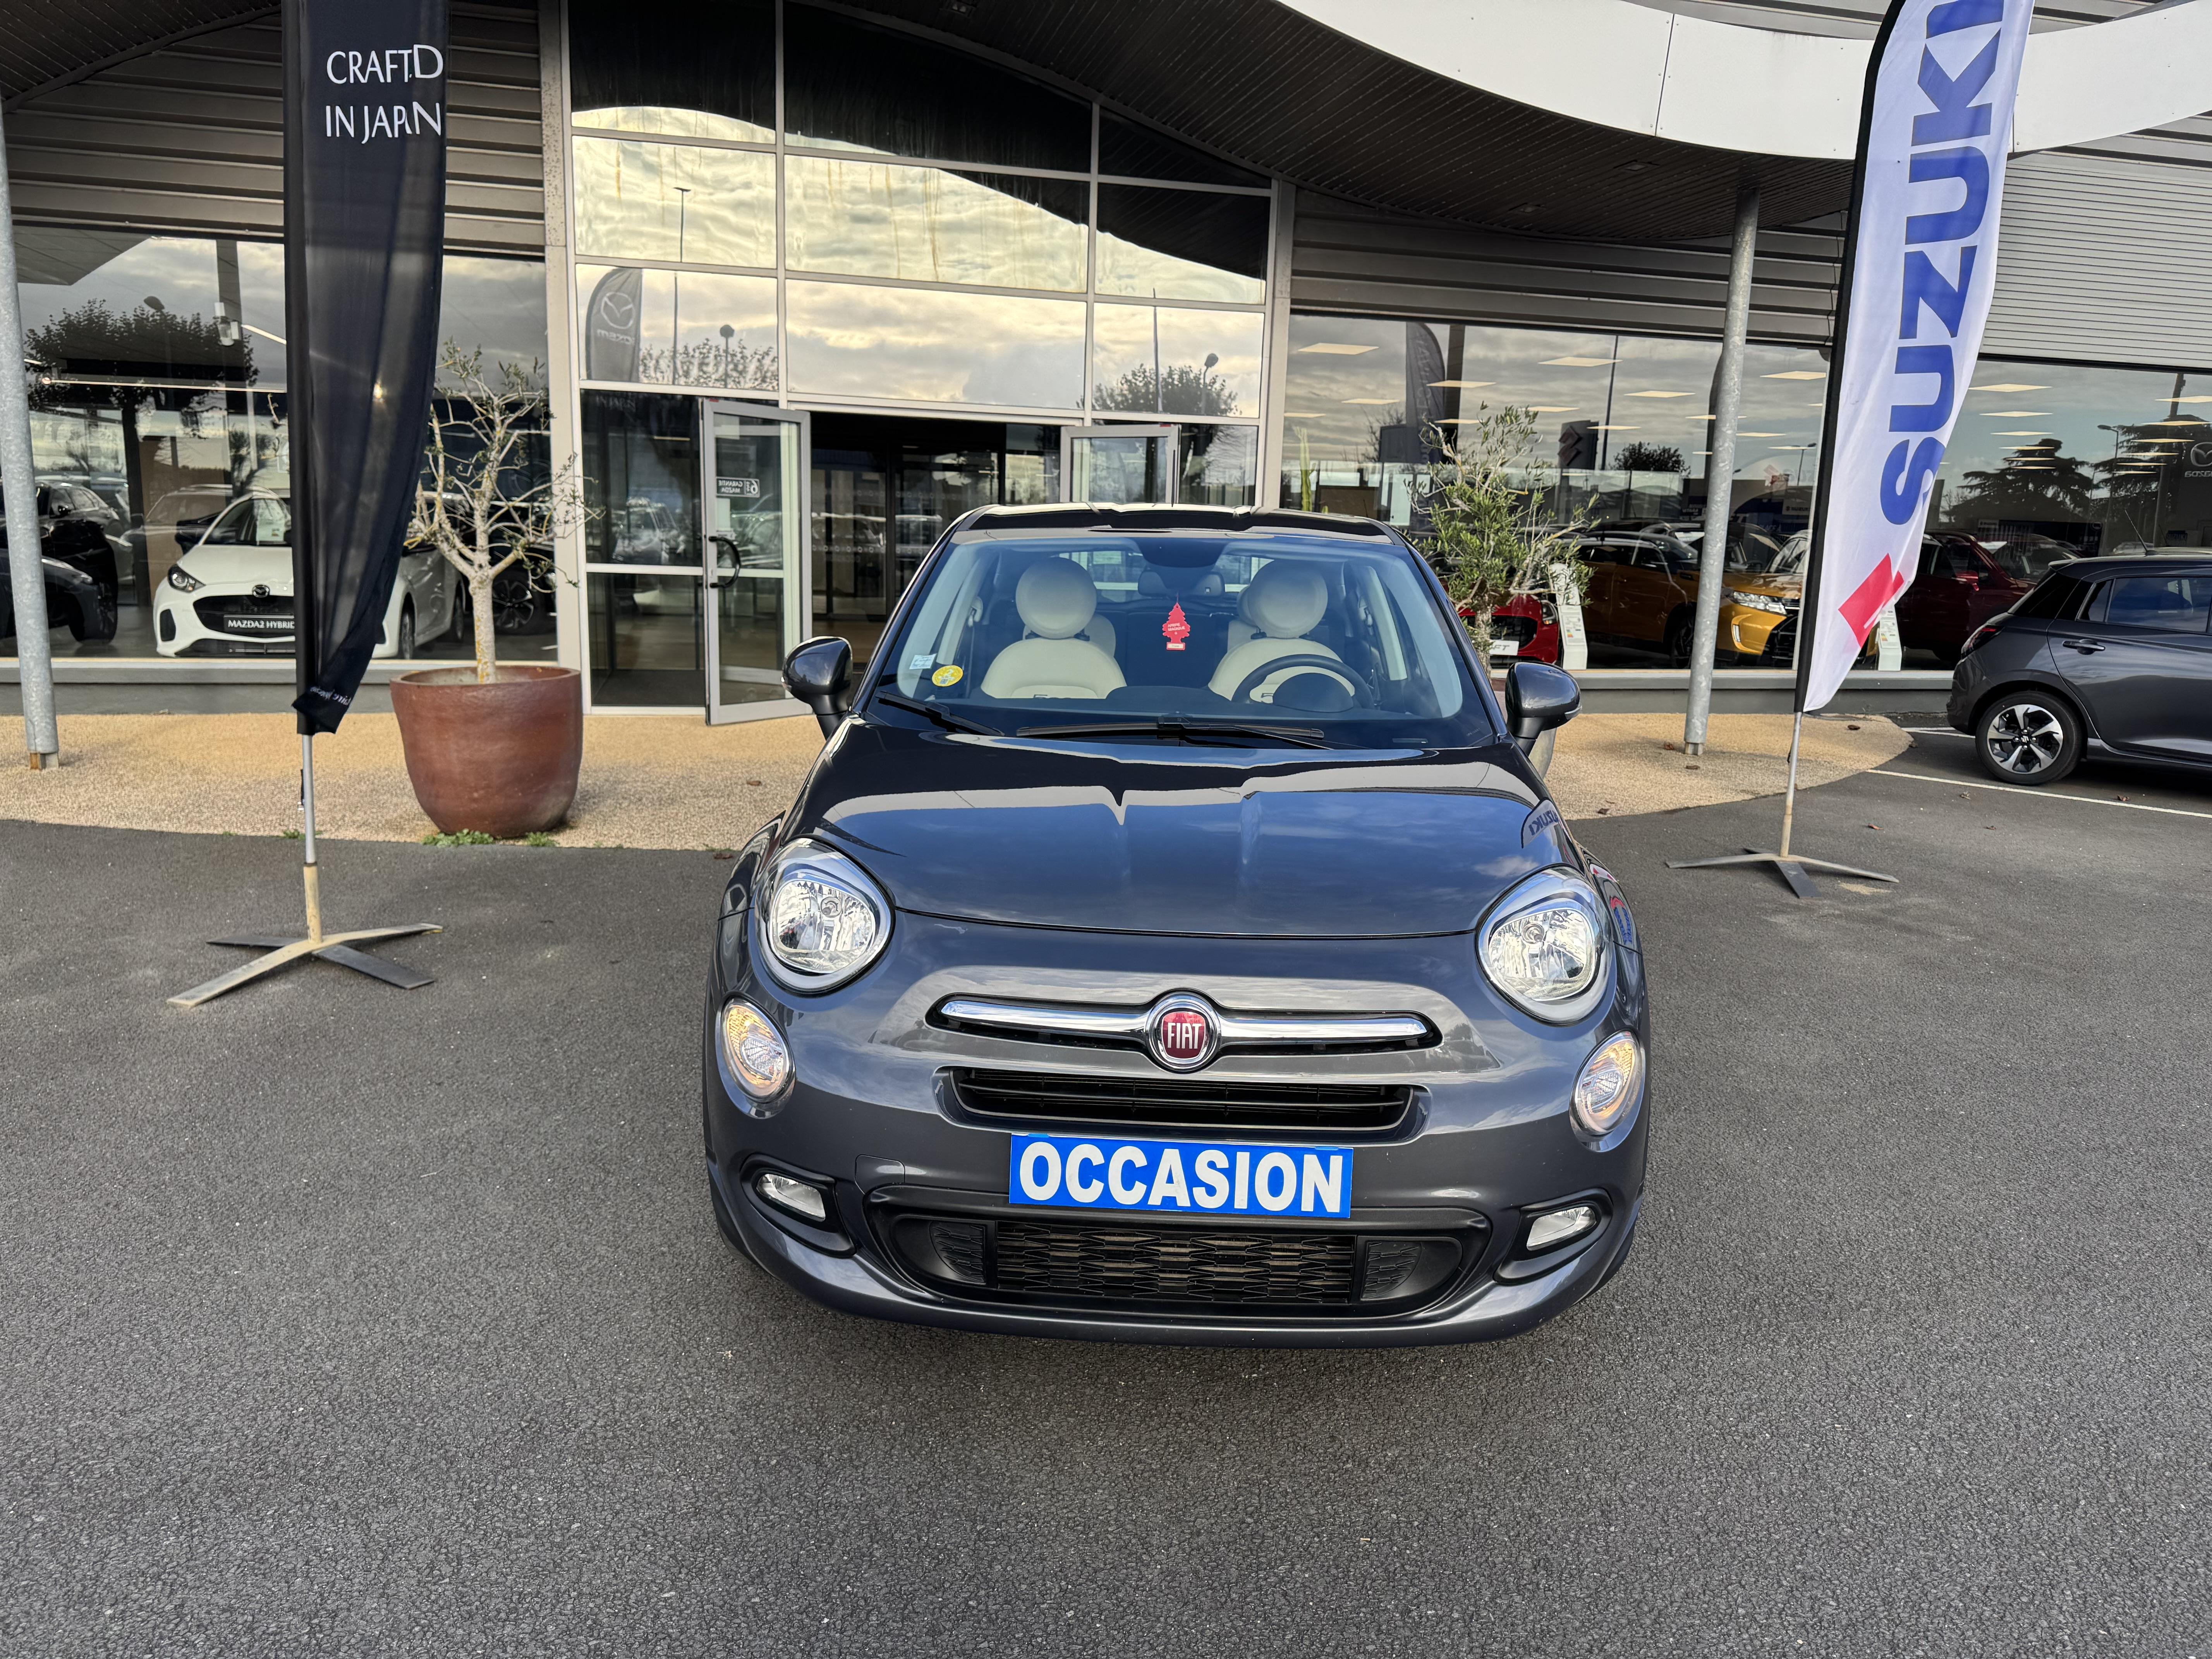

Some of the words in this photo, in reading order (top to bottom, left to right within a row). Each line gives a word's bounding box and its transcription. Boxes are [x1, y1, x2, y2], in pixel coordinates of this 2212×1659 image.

[326, 44, 444, 84] CRAFTD
[326, 105, 355, 138] IN
[1880, 0, 2004, 525] SUZUKI
[228, 620, 265, 628] MAZDA2
[1167, 1022, 1202, 1049] FIAT
[1019, 1141, 1343, 1213] OCCASION
